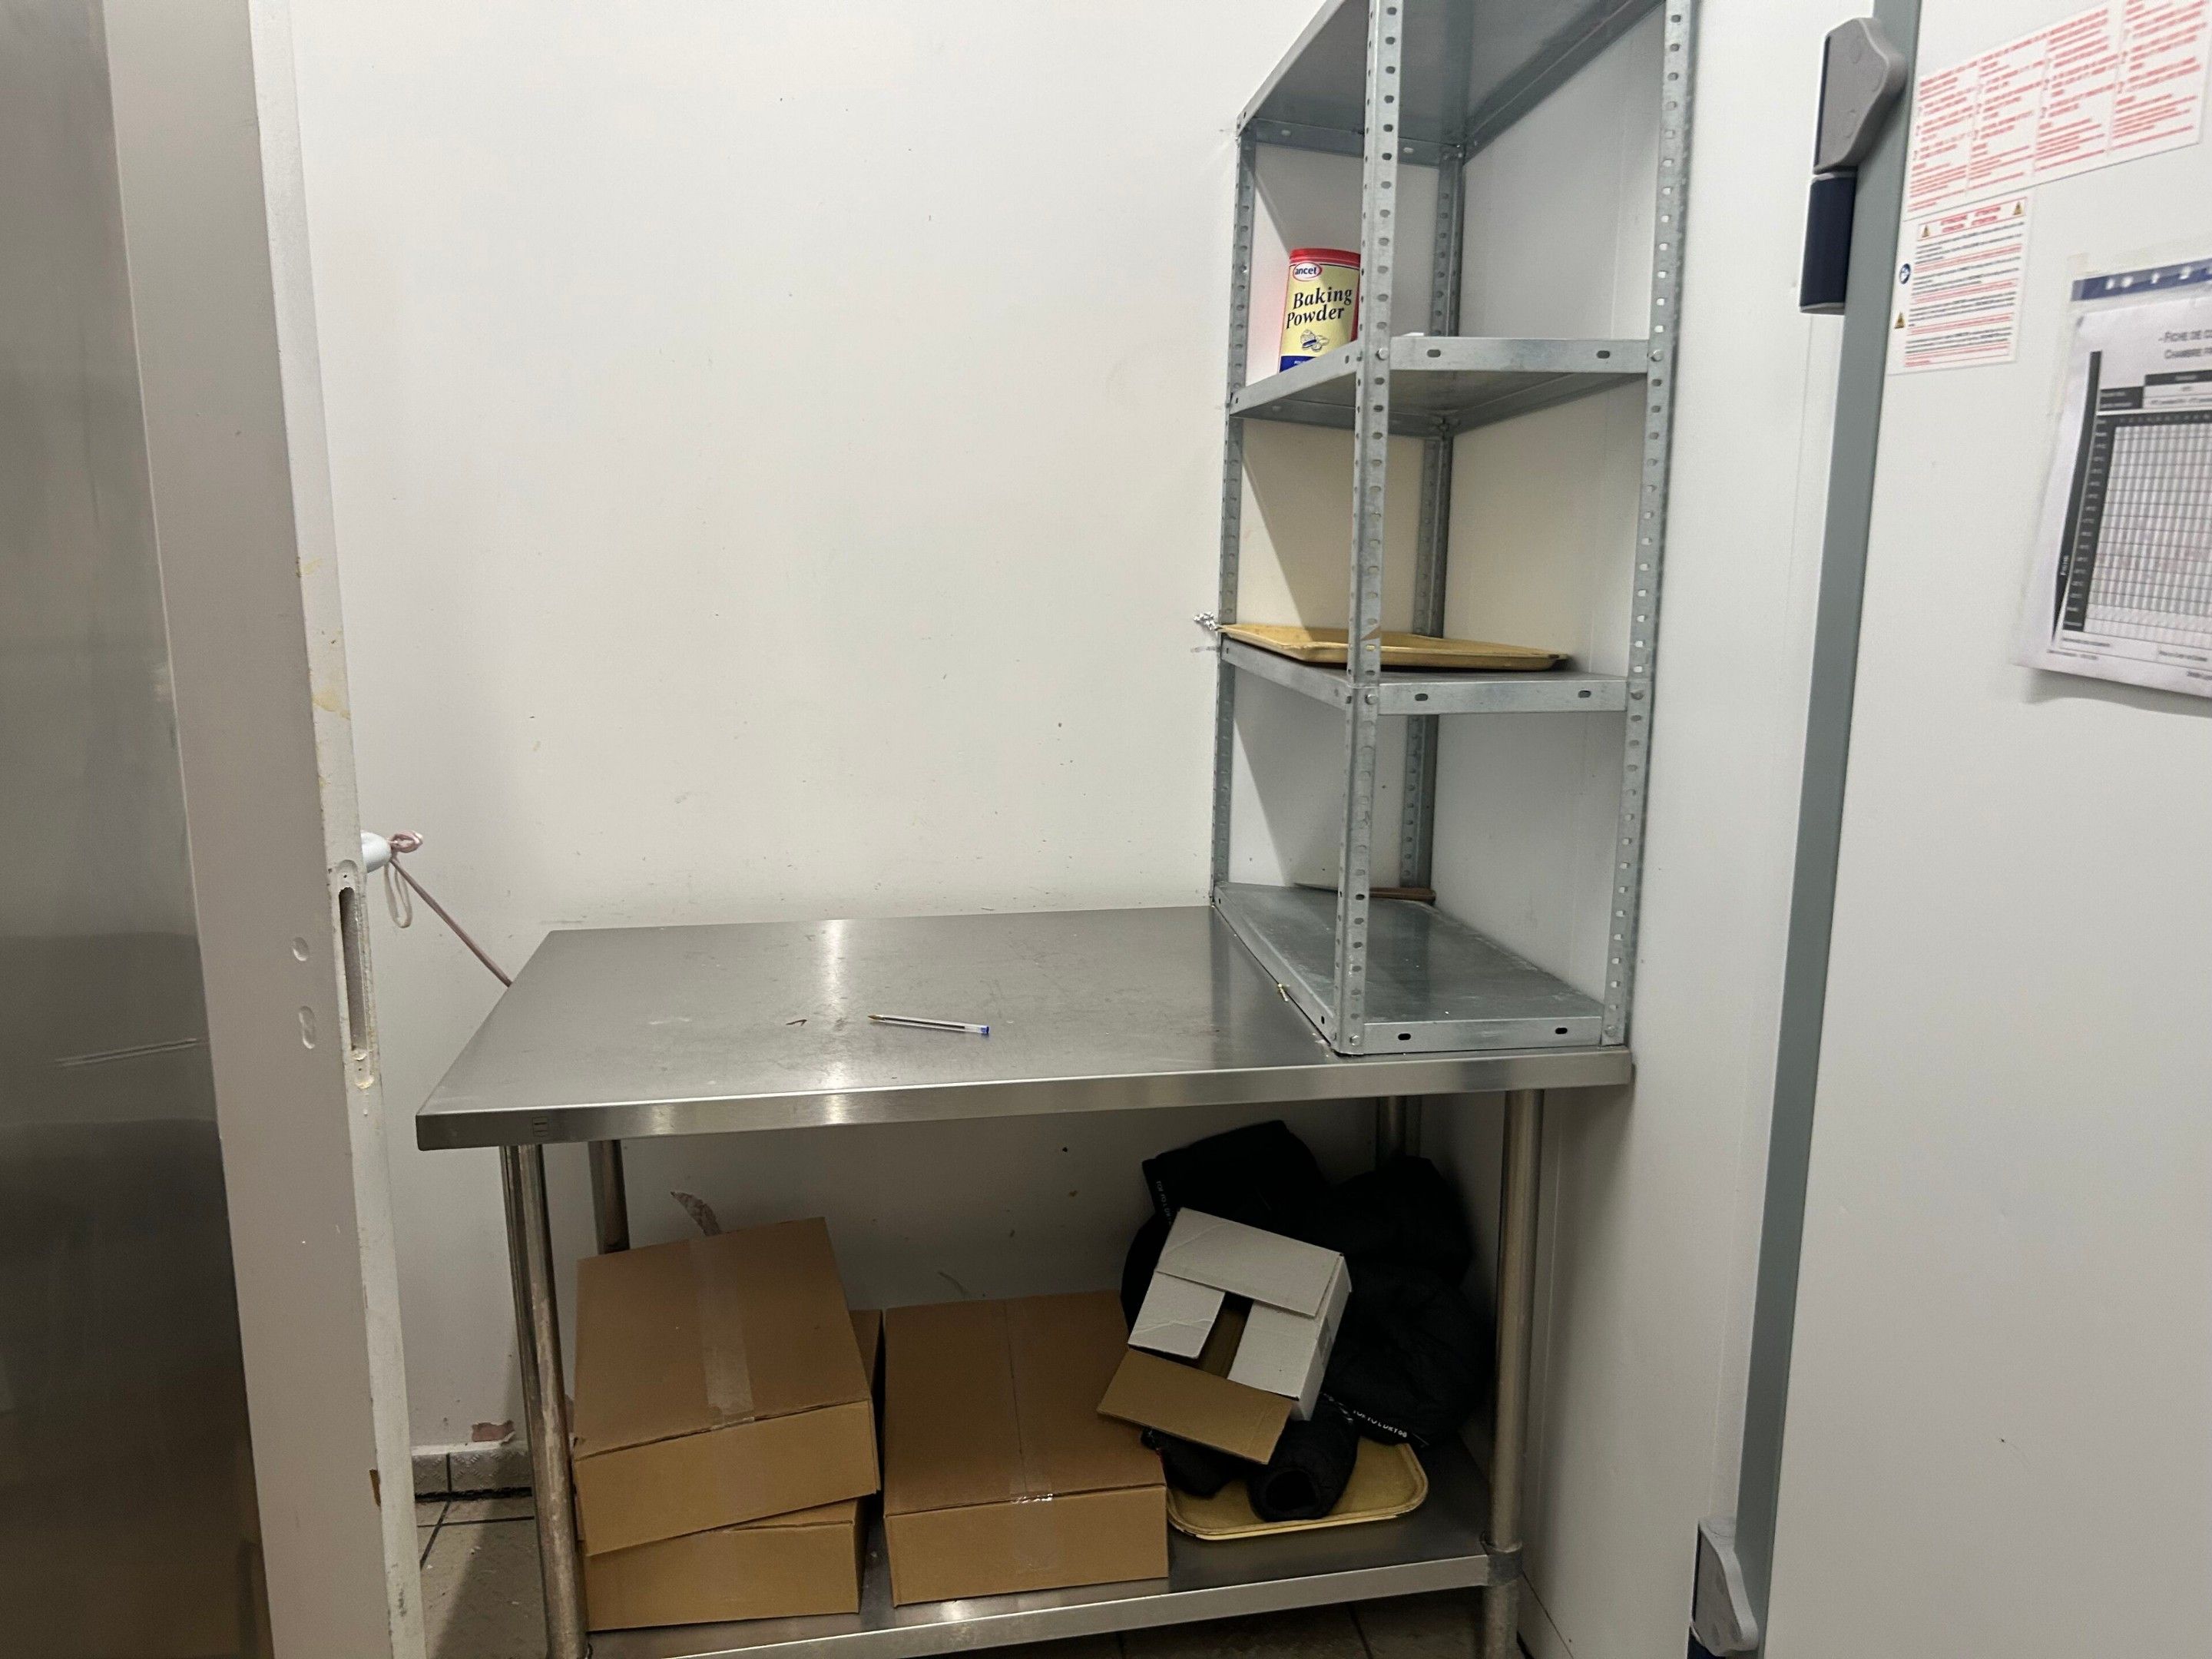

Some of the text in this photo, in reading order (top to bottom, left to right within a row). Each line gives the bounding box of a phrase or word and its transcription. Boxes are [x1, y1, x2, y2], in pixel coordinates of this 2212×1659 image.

[1295, 267, 1317, 275] ancel
[1293, 286, 1353, 310] Baking
[1286, 304, 1344, 329] Powder
